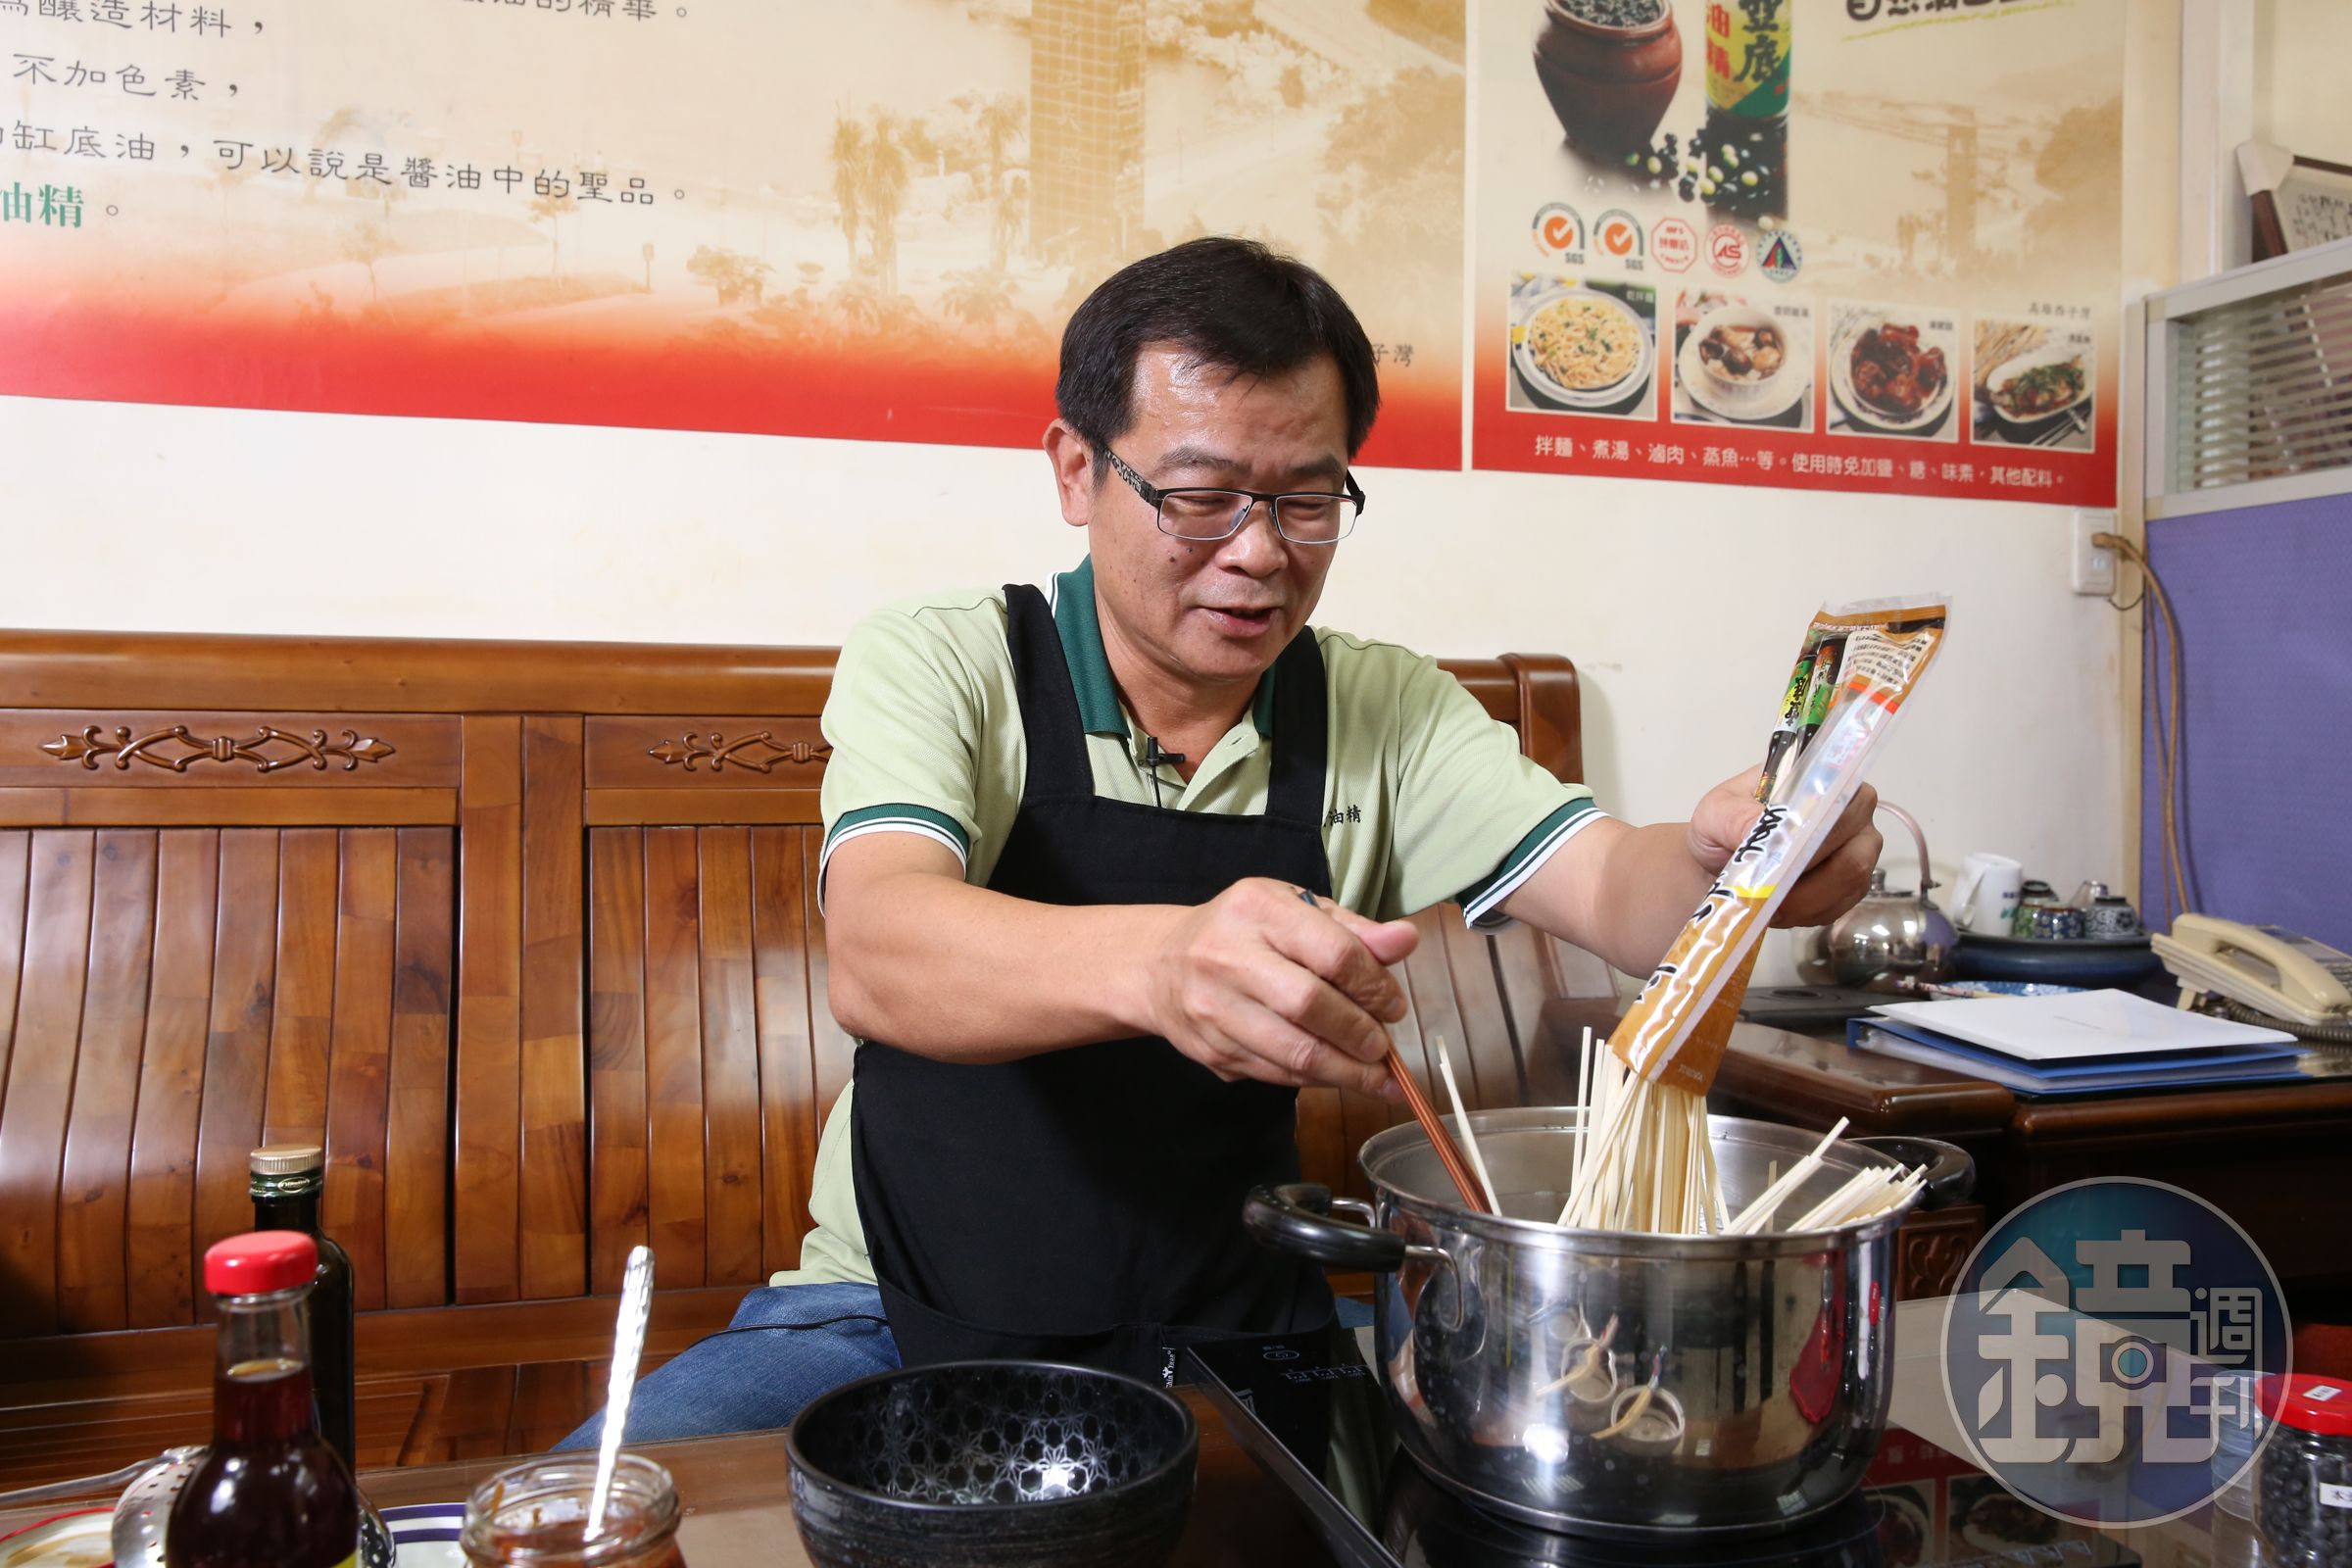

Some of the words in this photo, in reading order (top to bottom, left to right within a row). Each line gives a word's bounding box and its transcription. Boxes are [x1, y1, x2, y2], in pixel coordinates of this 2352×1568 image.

[13, 53, 238, 101] 不加色素，
[0, 120, 686, 206] 缸底油，可以說是醬油中的聖品。
